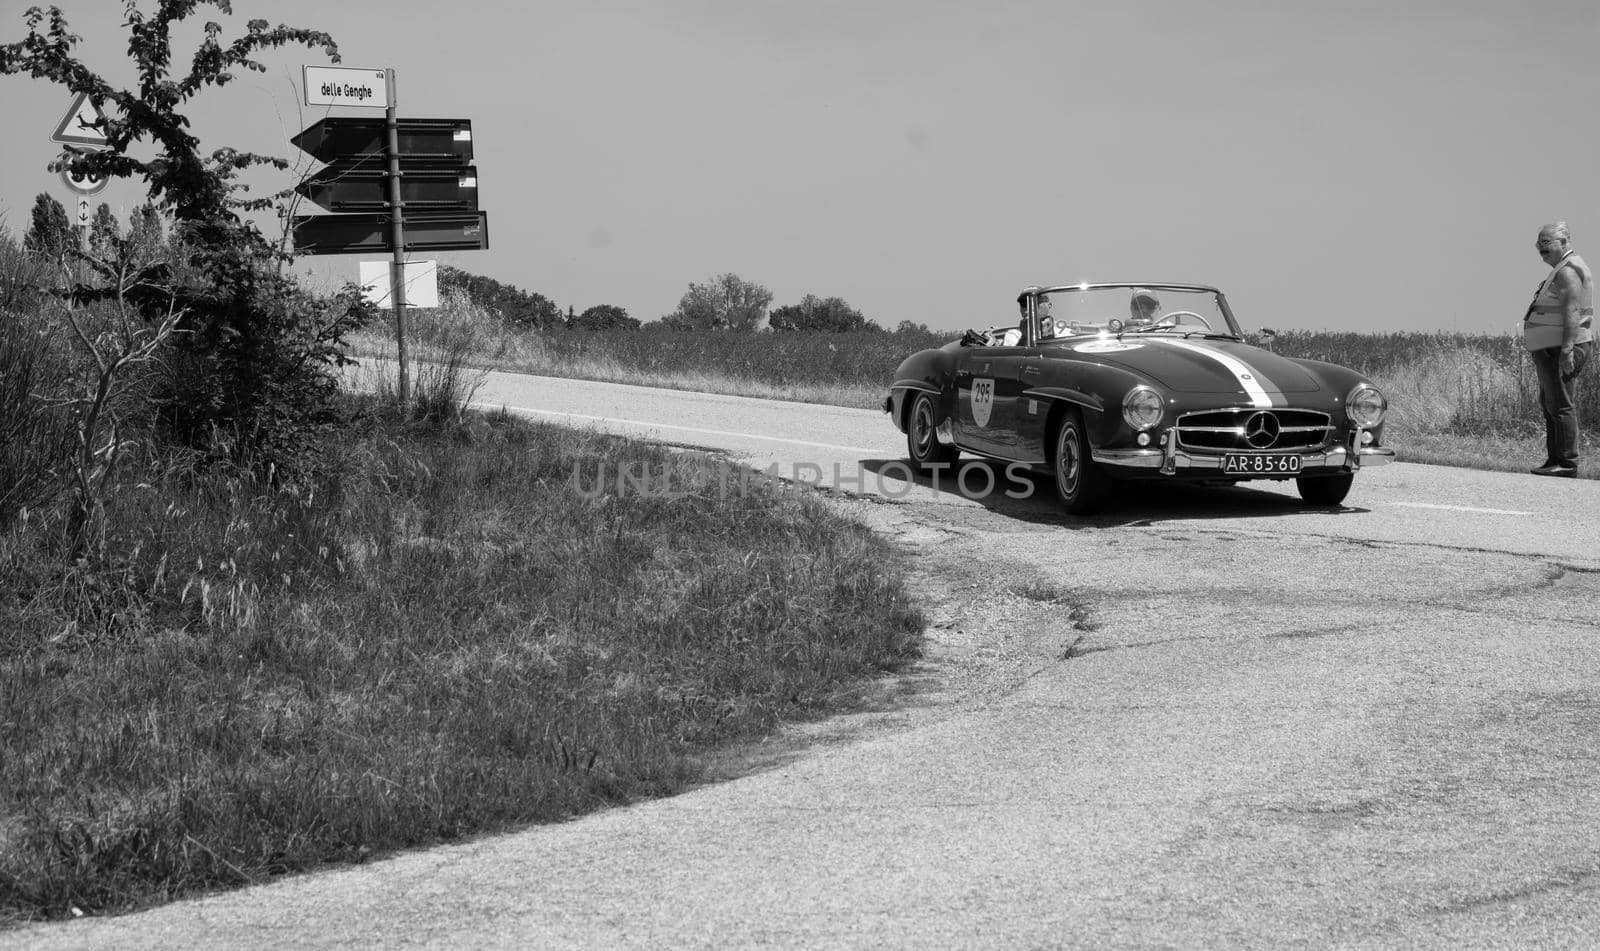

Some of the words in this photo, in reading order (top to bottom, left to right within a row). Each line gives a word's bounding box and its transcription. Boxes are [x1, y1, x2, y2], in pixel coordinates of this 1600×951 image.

[321, 81, 342, 97] delle
[344, 83, 372, 101] Genghe
[975, 382, 991, 404] 295
